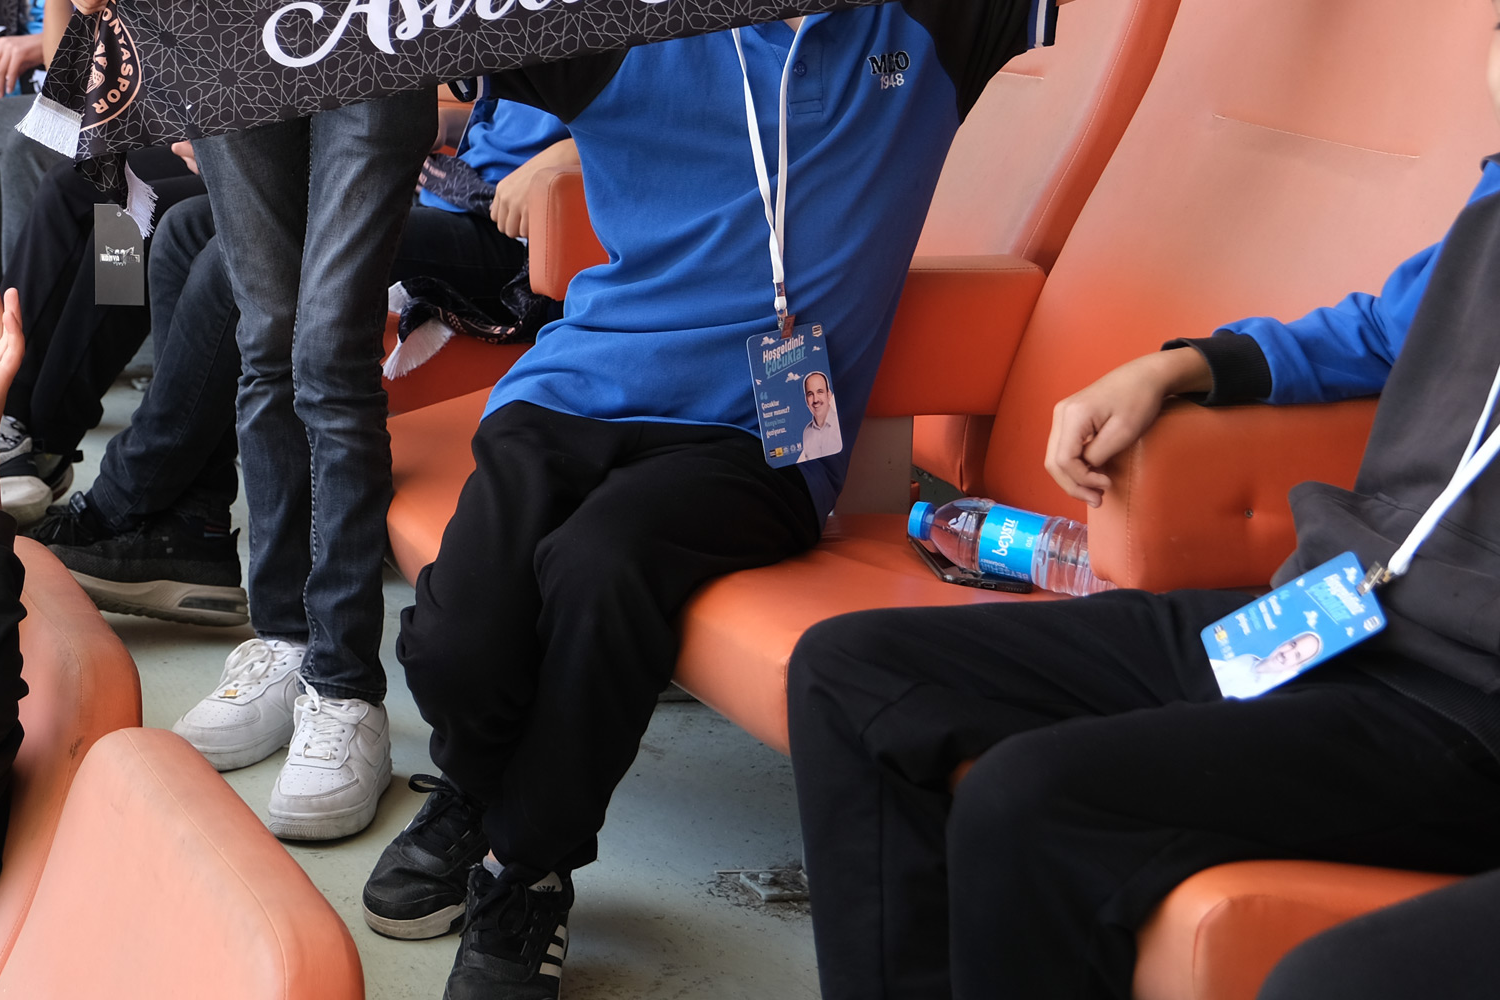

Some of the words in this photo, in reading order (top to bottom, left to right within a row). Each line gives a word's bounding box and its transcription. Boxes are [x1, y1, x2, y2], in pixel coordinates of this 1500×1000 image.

[92, 7, 133, 114] ONYASPOR
[867, 51, 910, 75] MEO
[881, 73, 904, 90] 1948
[762, 334, 805, 364] Hoşgeldiniz
[765, 346, 806, 378] Çocuklar
[992, 518, 1015, 557] beysu
